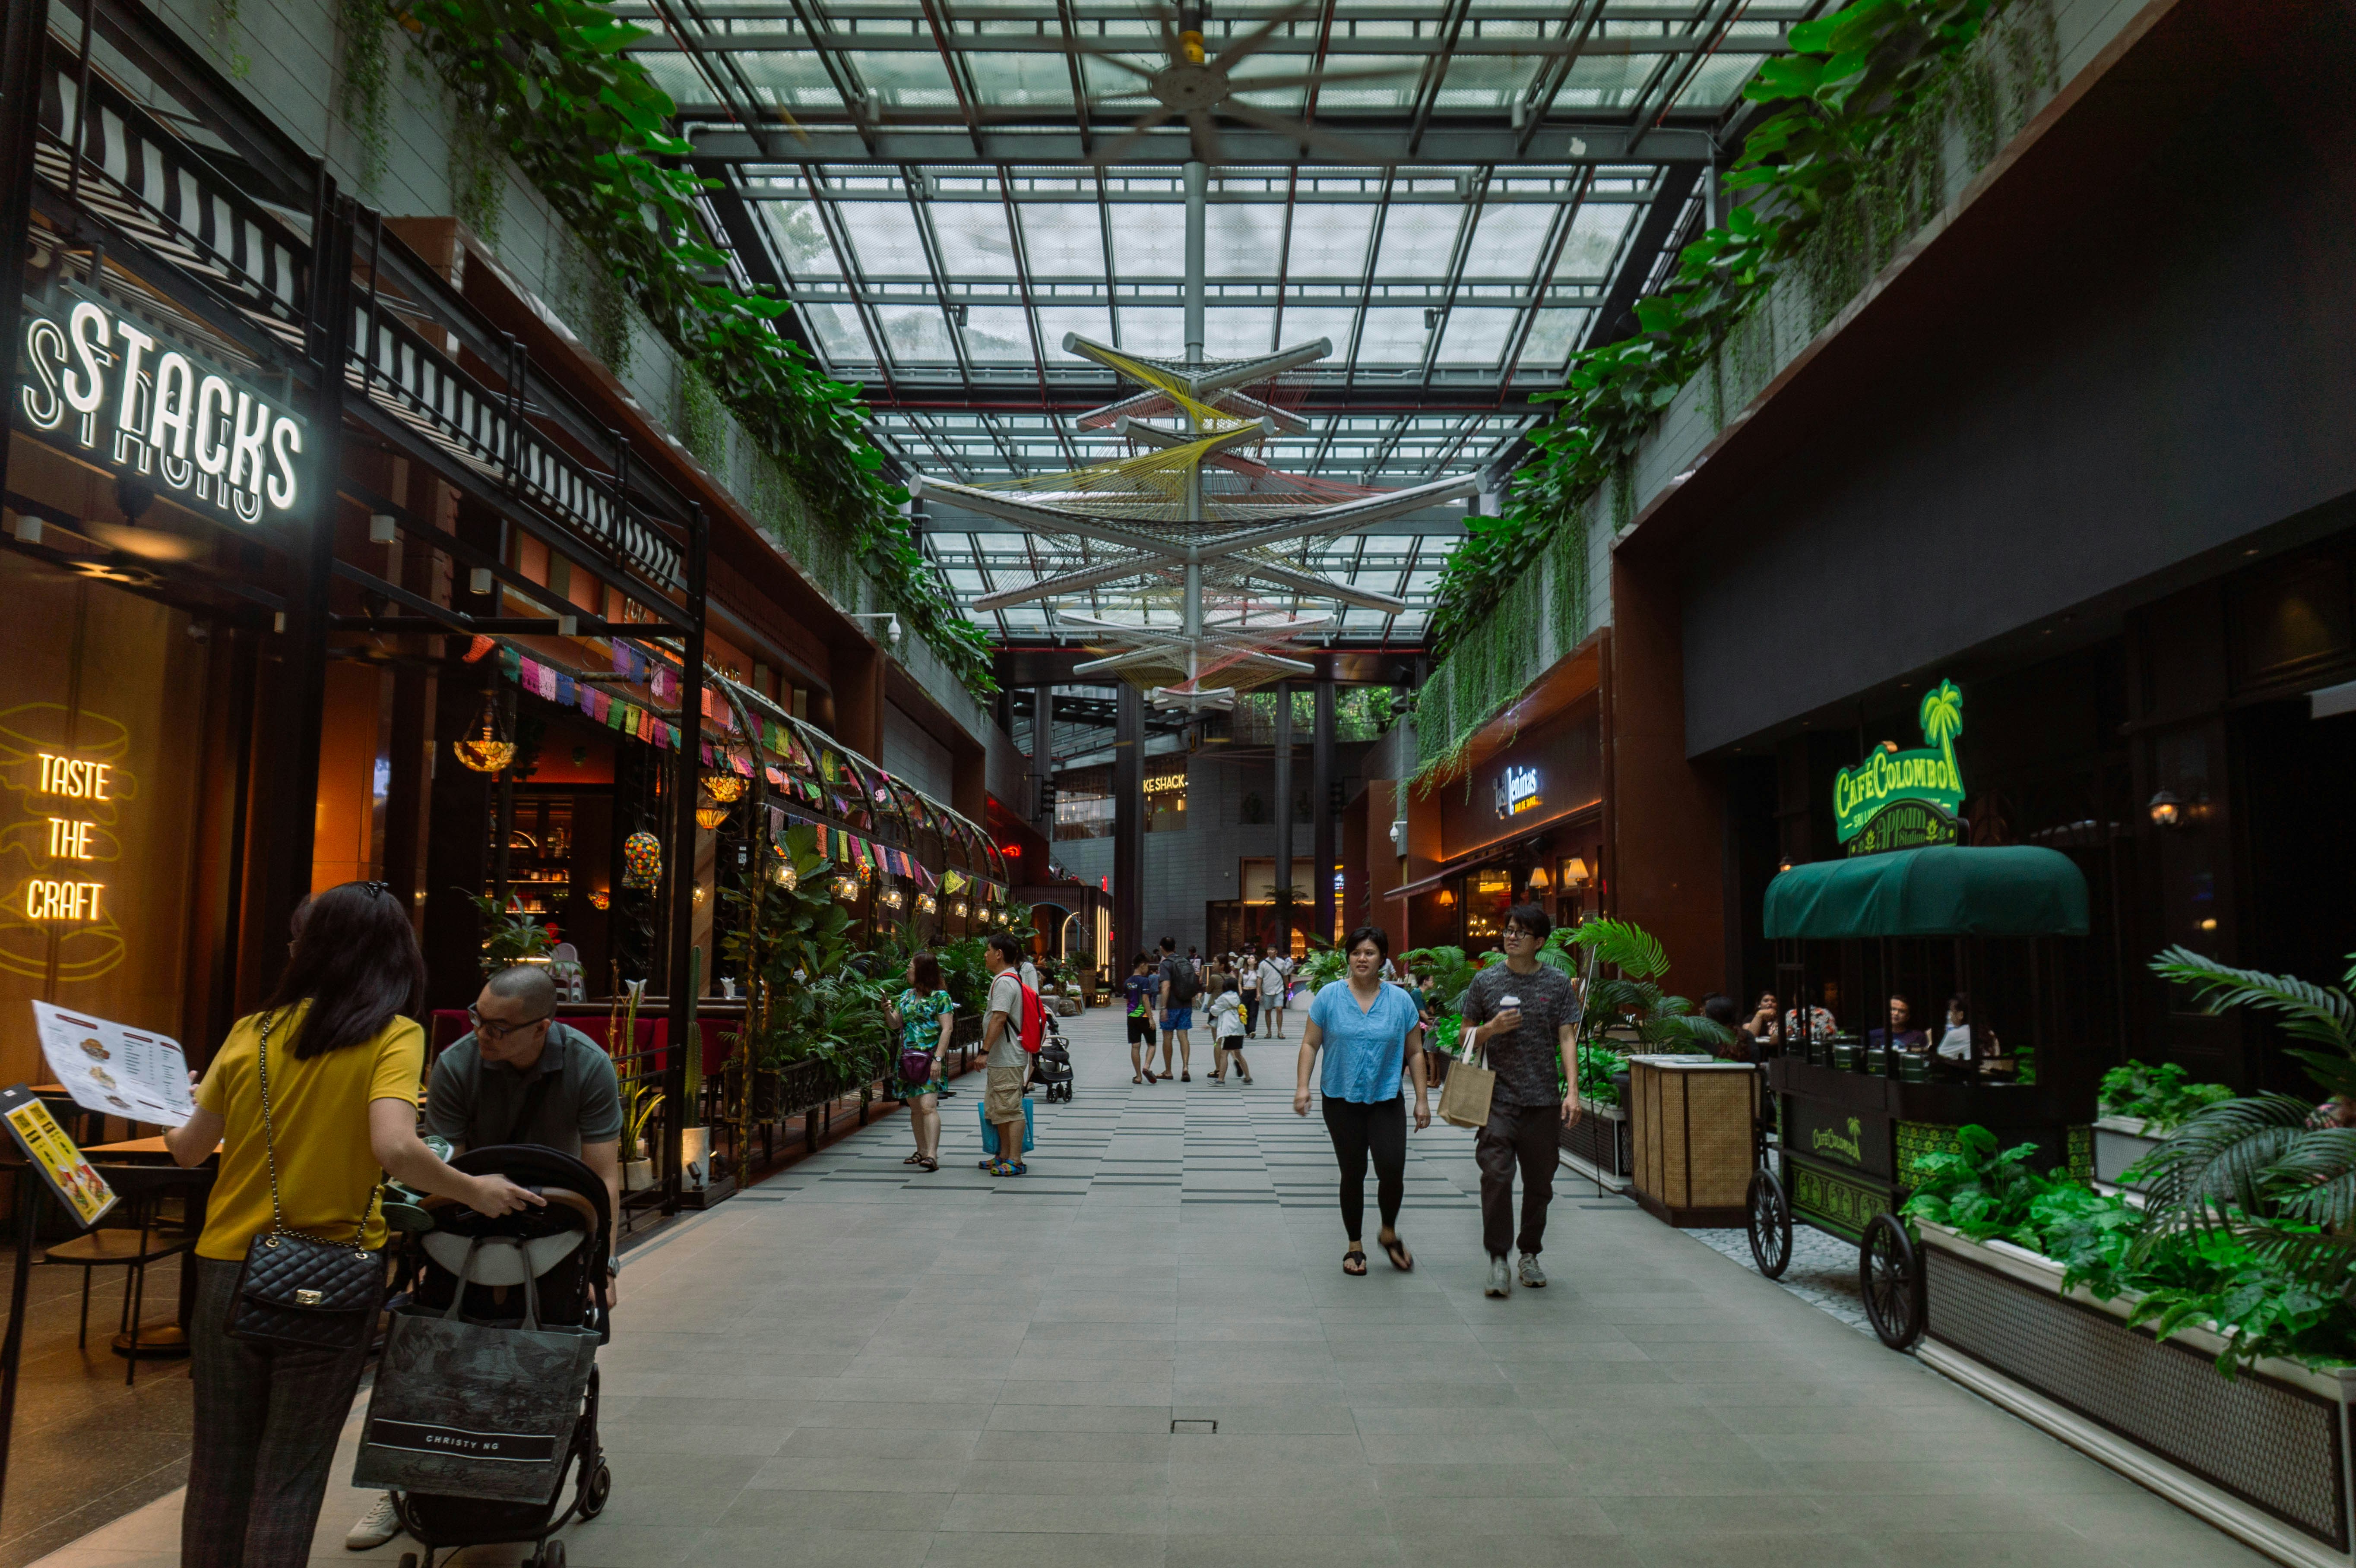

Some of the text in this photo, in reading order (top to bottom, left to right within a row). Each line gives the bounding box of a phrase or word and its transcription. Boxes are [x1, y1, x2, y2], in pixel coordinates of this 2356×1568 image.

[63, 301, 302, 510] STACKS
[38, 753, 112, 801] TASTE
[1155, 774, 1185, 791] SHACK
[1837, 752, 1948, 818] CAFÉ COLOMBO
[48, 817, 96, 860] THE
[1853, 813, 1864, 828] SRI
[27, 879, 105, 921] CRAFT
[426, 1435, 477, 1449] CHRISTY
